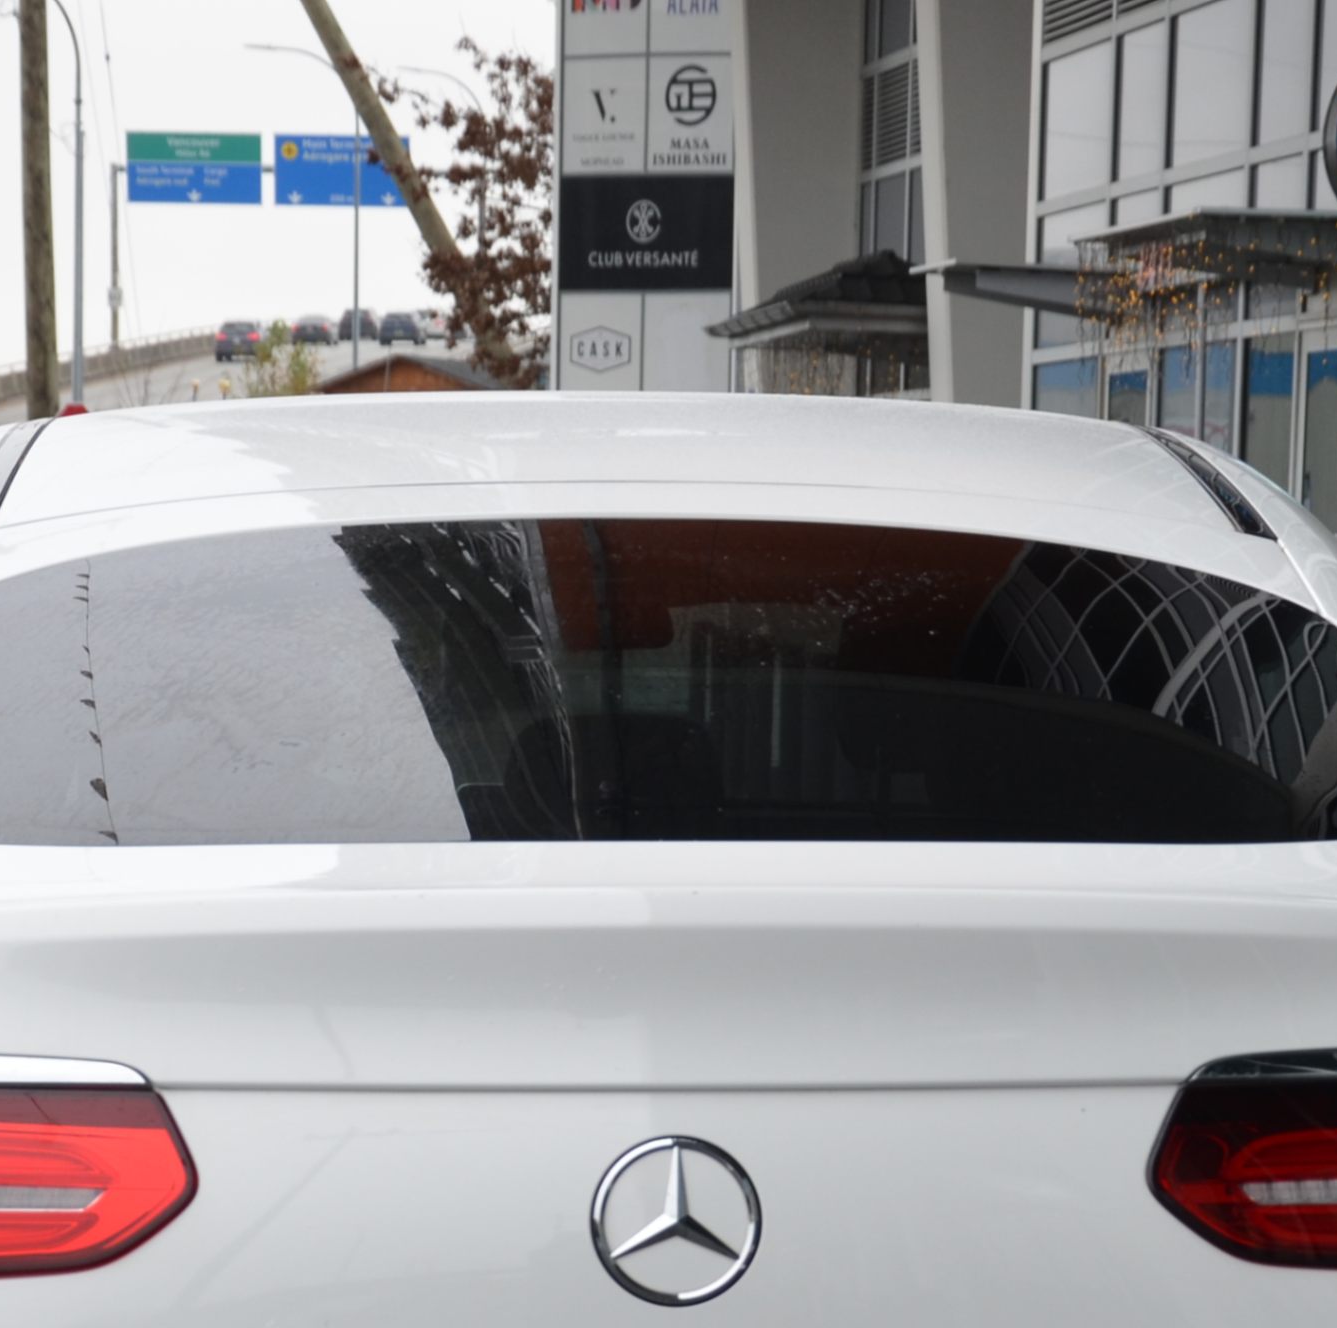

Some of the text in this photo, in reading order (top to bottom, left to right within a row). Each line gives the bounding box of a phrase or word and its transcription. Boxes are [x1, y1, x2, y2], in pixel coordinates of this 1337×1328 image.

[670, 137, 710, 150] MASA
[652, 152, 727, 166] ISHIBASHI
[588, 249, 699, 268] CLUB VERSANTÉ
[577, 341, 623, 357] CASK
